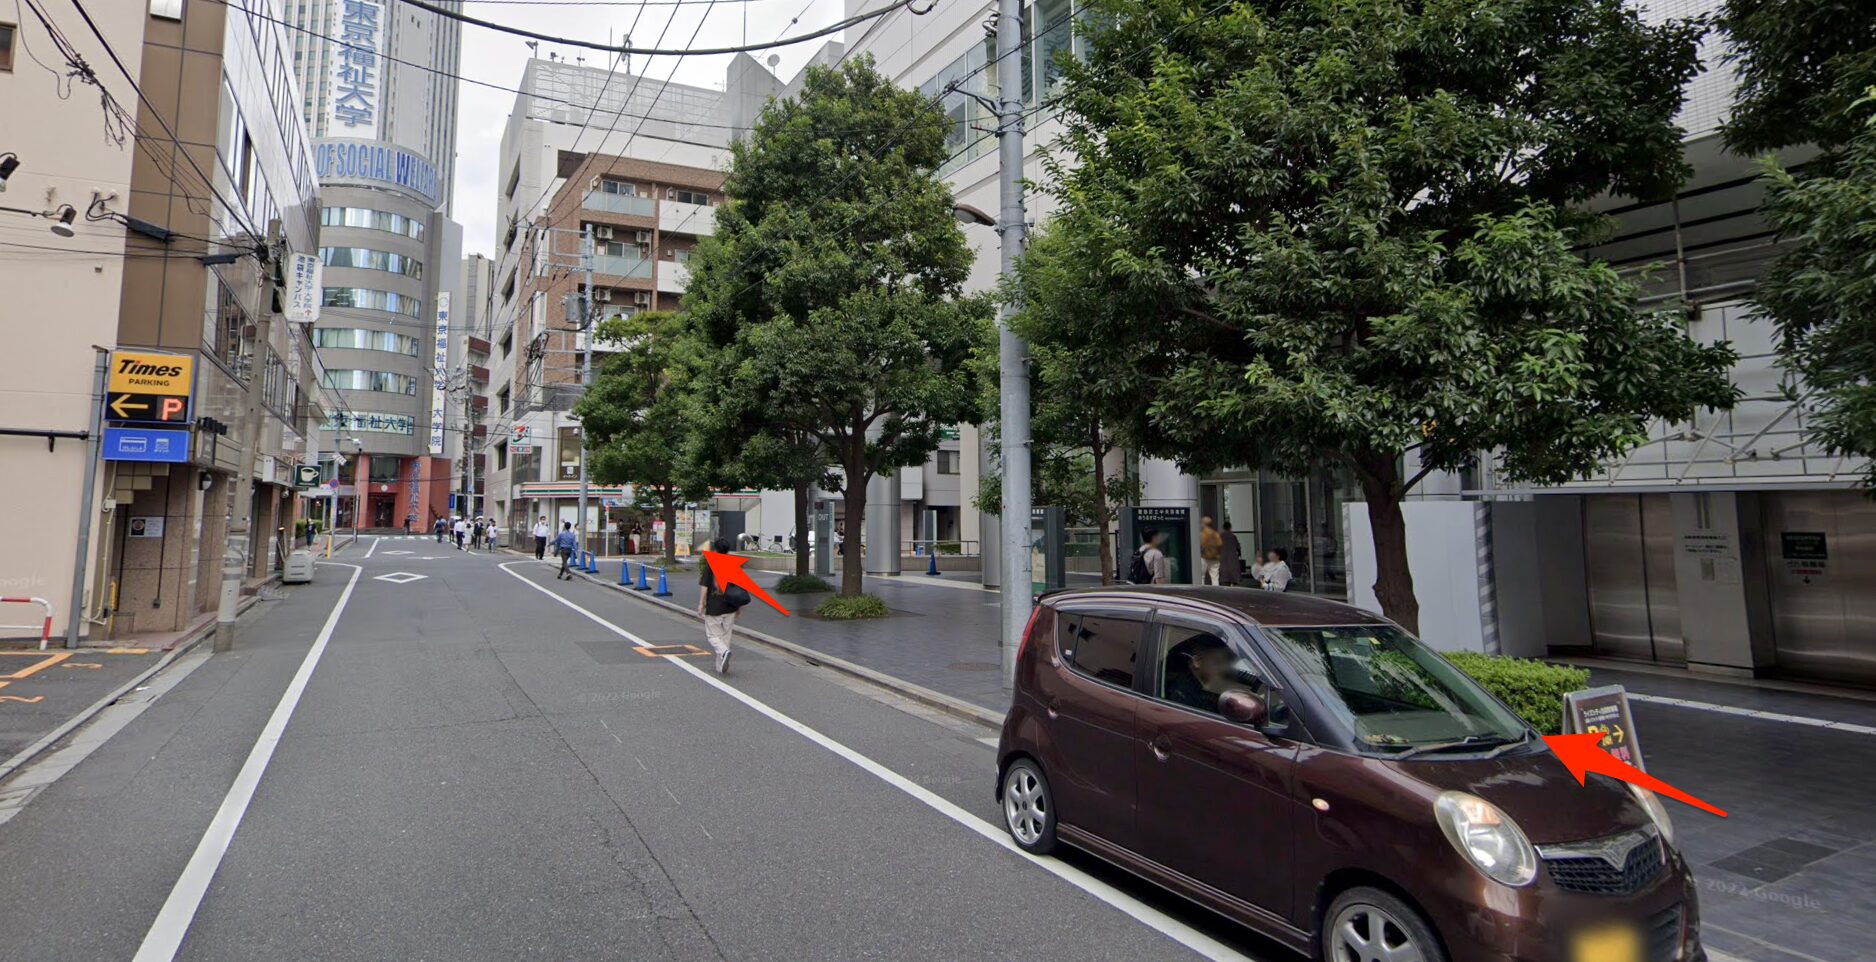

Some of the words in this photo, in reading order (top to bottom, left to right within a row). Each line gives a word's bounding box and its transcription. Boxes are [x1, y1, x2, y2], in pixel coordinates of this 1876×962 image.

[335, 0, 378, 128] 東京福祉大学
[315, 143, 335, 178] OF
[336, 143, 392, 183] SOCIAL
[118, 359, 183, 377] Times
[128, 378, 170, 387] PARKING
[162, 398, 184, 421] P
[818, 513, 829, 521] OUT
